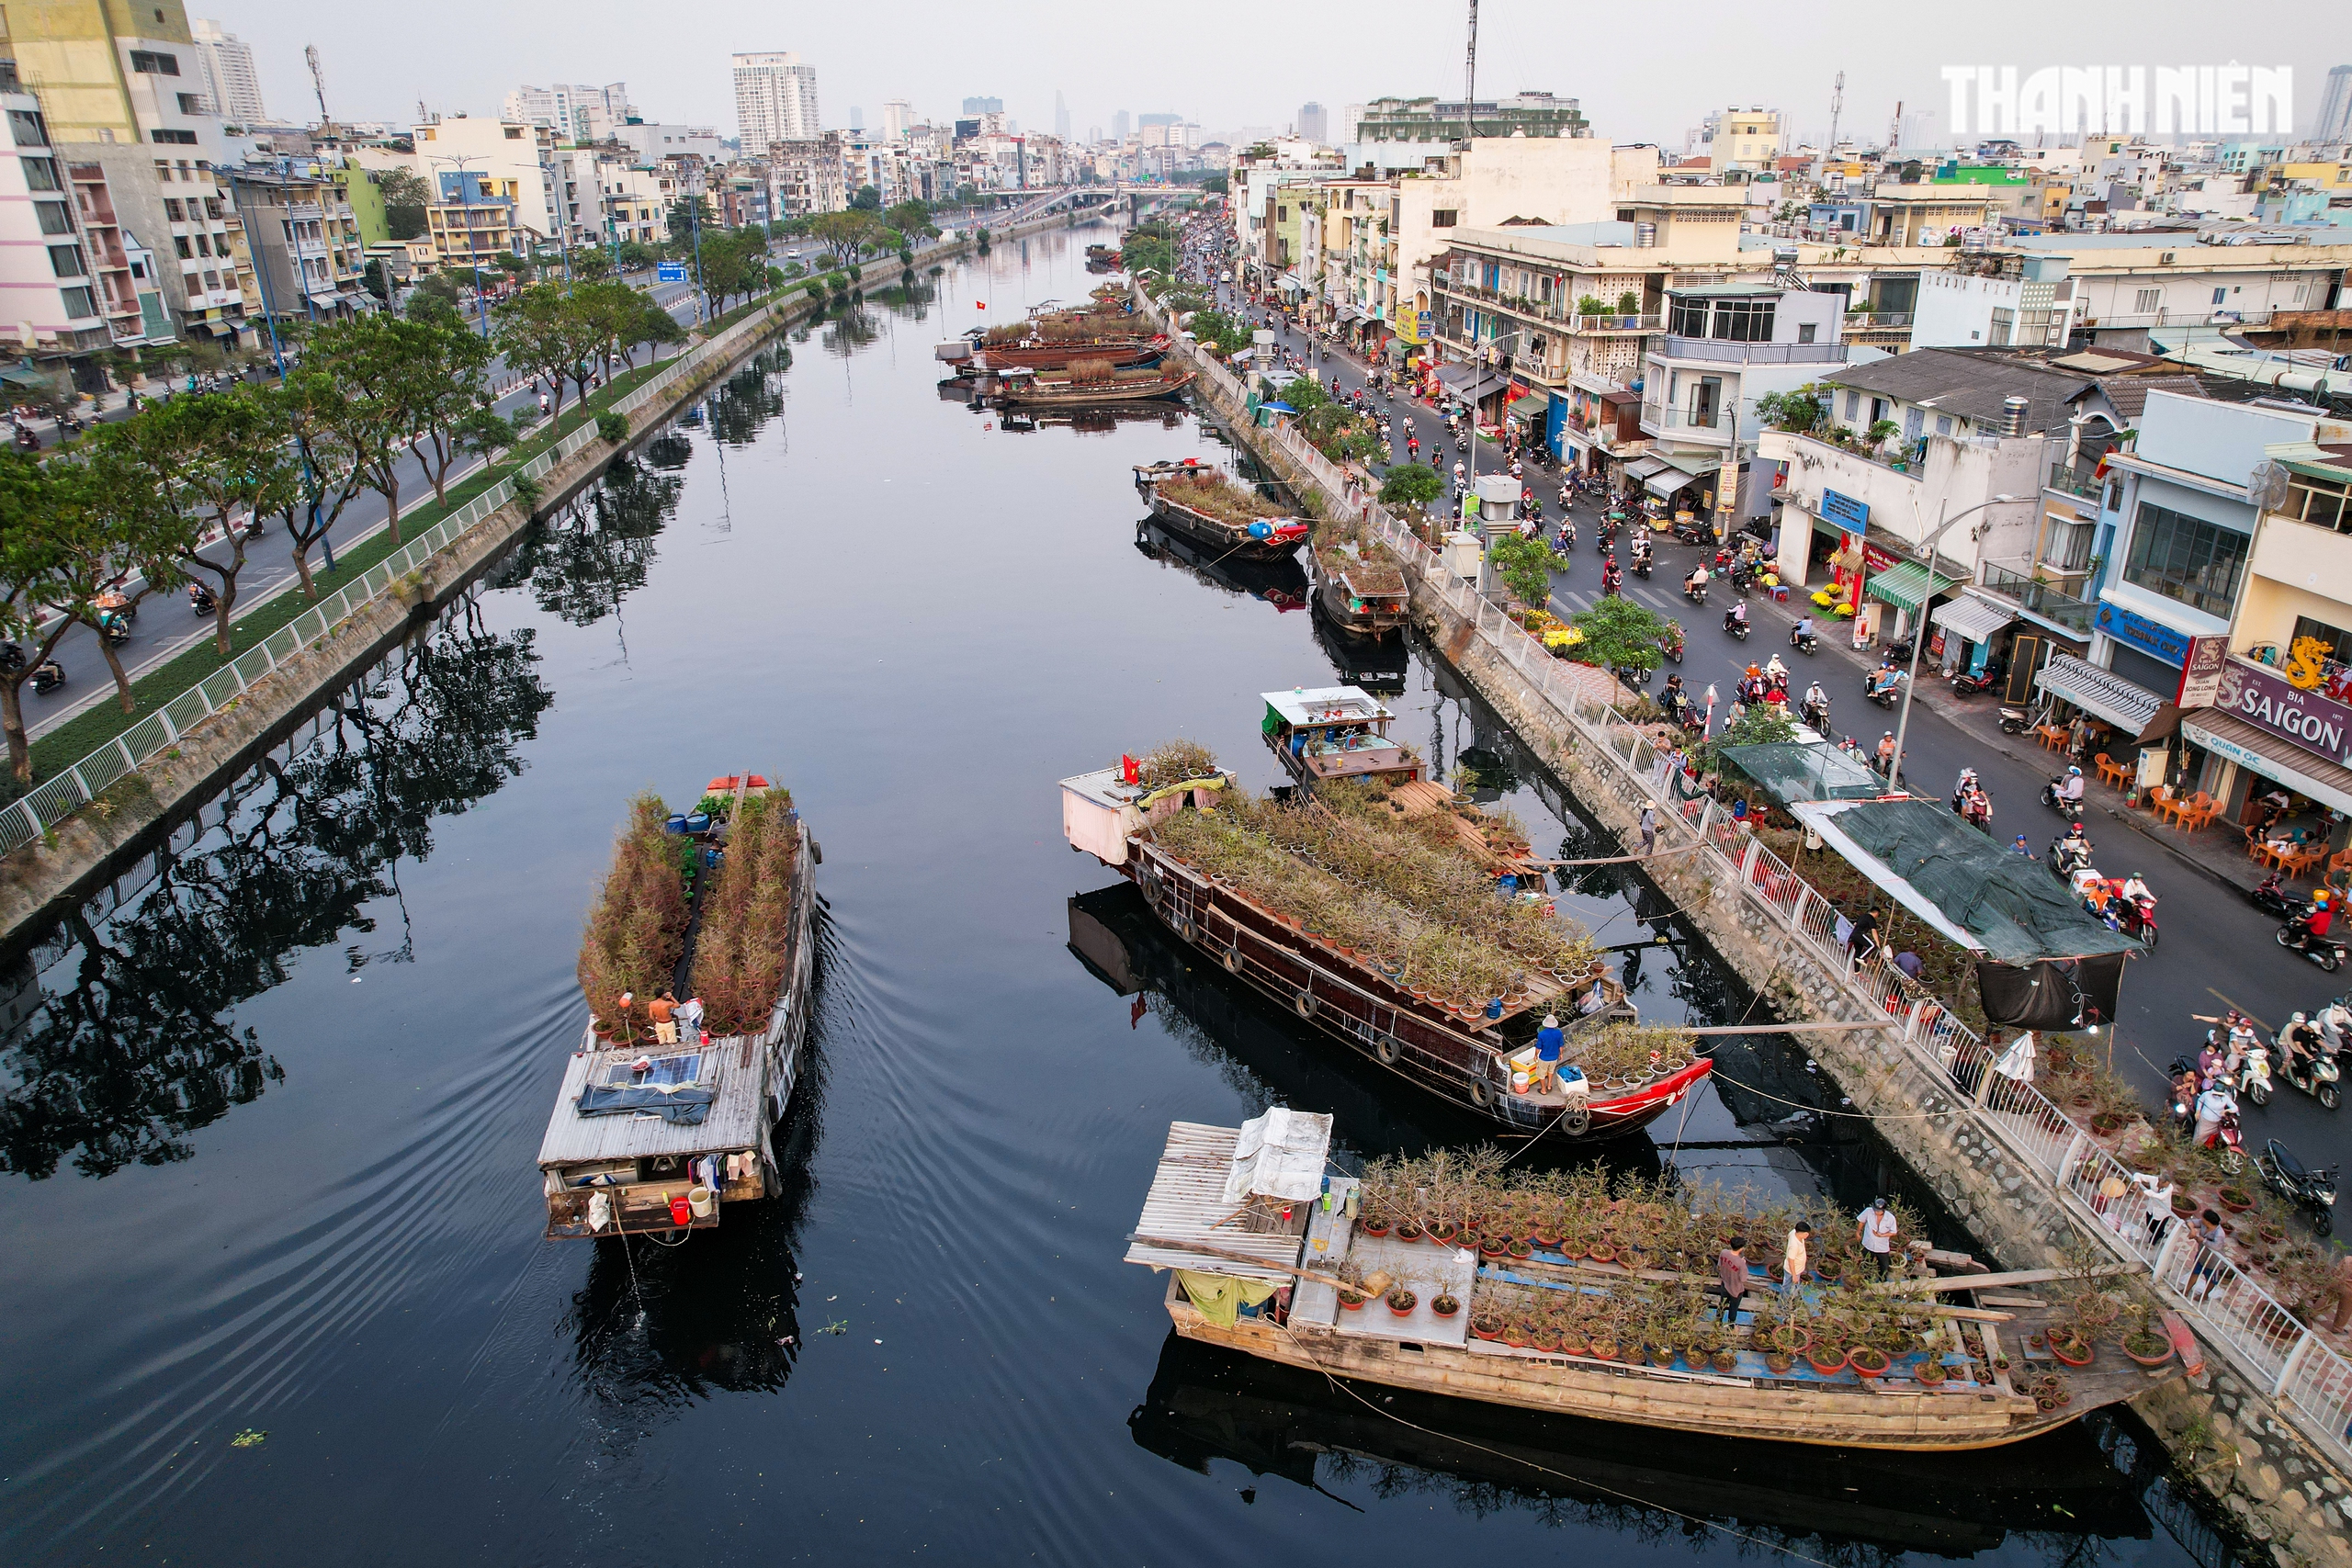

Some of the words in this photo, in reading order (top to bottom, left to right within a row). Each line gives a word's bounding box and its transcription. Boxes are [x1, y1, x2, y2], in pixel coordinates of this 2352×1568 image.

[2192, 663, 2220, 671] SAIGON
[2252, 679, 2262, 688] EST.
[2287, 690, 2304, 705] BIA
[2241, 688, 2344, 752] SAIGON
[2332, 713, 2343, 722] 1875
[2211, 738, 2241, 756] QUÁN
[1810, 828, 1815, 838] 9
